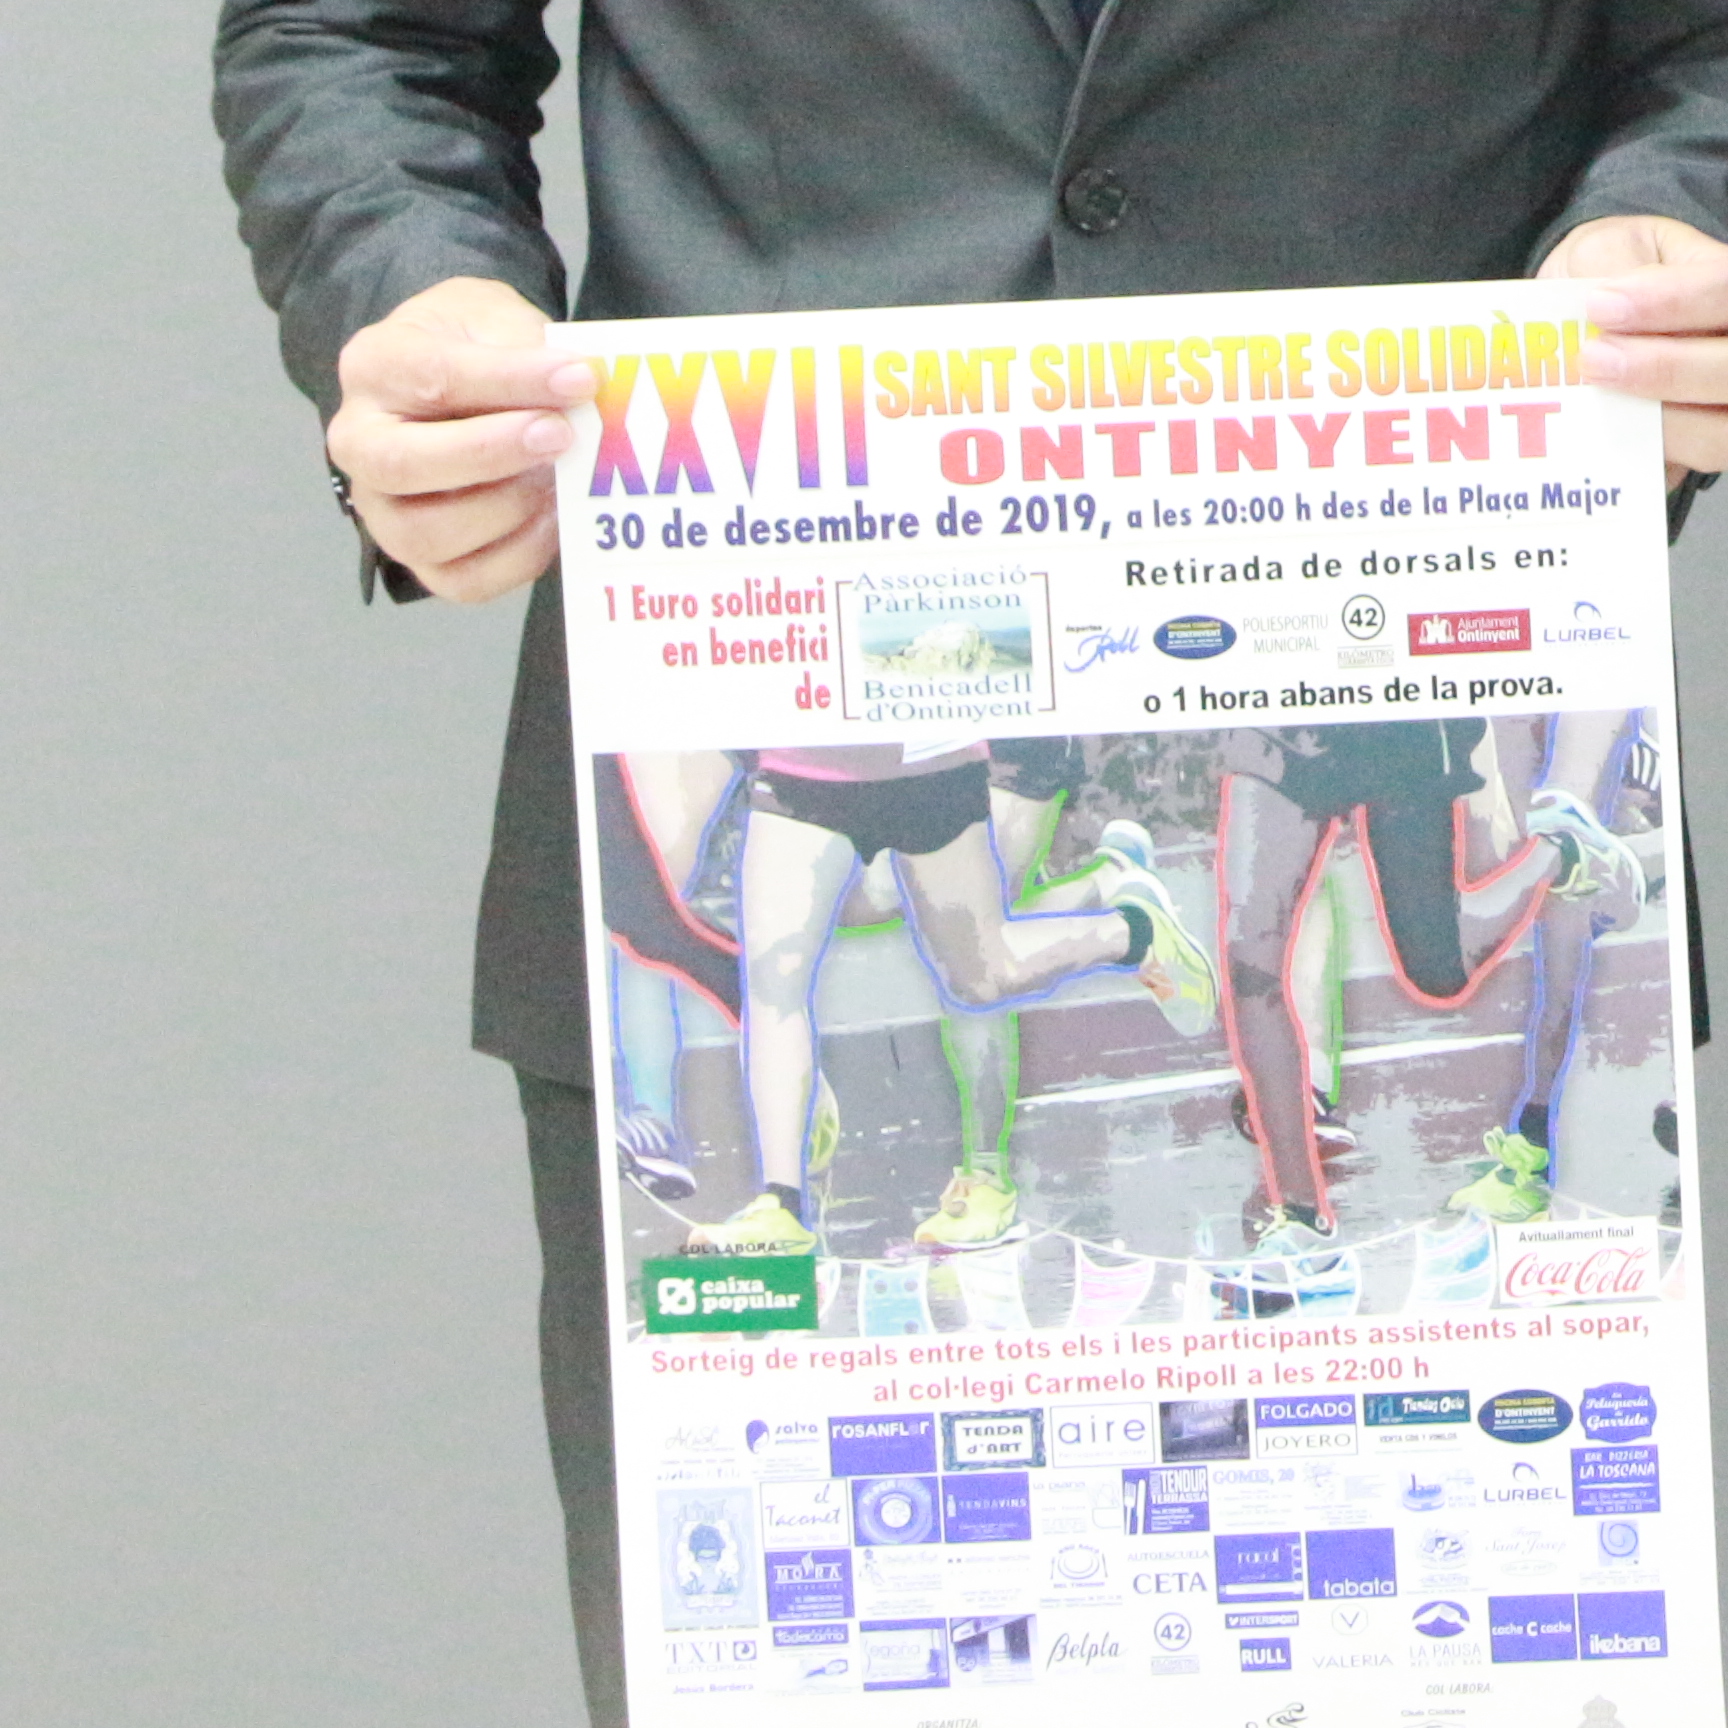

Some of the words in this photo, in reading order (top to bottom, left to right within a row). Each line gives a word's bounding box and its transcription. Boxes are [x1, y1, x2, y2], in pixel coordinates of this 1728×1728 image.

[588, 345, 868, 498] XXVII
[873, 346, 1016, 419] SANT
[1029, 332, 1313, 412] SILVESTRE
[1326, 310, 1599, 398] SOLIDÀRI
[939, 402, 1561, 486] ONTINYENT
[595, 512, 644, 550] 30
[661, 507, 707, 548] de
[723, 499, 919, 546] desembre
[935, 495, 982, 537] de
[999, 493, 1110, 539] 2019,
[1126, 510, 1142, 528] a
[1153, 499, 1191, 528] les
[1203, 496, 1284, 525] 20:00
[1295, 492, 1310, 521] h
[1322, 490, 1368, 519] des
[1379, 488, 1411, 517] de
[1423, 486, 1447, 515] la
[1458, 484, 1528, 518] Plaça
[1540, 477, 1620, 515] Major
[1125, 555, 1282, 586] Retirada
[1301, 552, 1341, 578] de
[1360, 545, 1496, 576] dorsals
[1514, 548, 1567, 568] en:
[603, 585, 615, 621] 1
[631, 584, 698, 621] Euro
[710, 576, 825, 617] solidari
[662, 642, 697, 667] en
[709, 623, 828, 665] benefici
[794, 670, 830, 710] de
[1143, 694, 1161, 713] o
[1172, 686, 1185, 711] 1
[1200, 685, 1268, 710] hora
[1280, 681, 1372, 707] abans
[1383, 676, 1419, 702] de
[1431, 674, 1457, 700] la
[1469, 676, 1562, 705] prova.
[700, 1276, 768, 1293] caixa
[700, 1288, 801, 1314] popular
[1260, 1401, 1353, 1420] FOLGADO
[1057, 1415, 1145, 1444] aire
[1265, 1433, 1351, 1451] JOYERO
[1132, 1571, 1207, 1594] CETA
[1323, 1577, 1395, 1598] tabata
[1241, 1646, 1286, 1665] RULL
